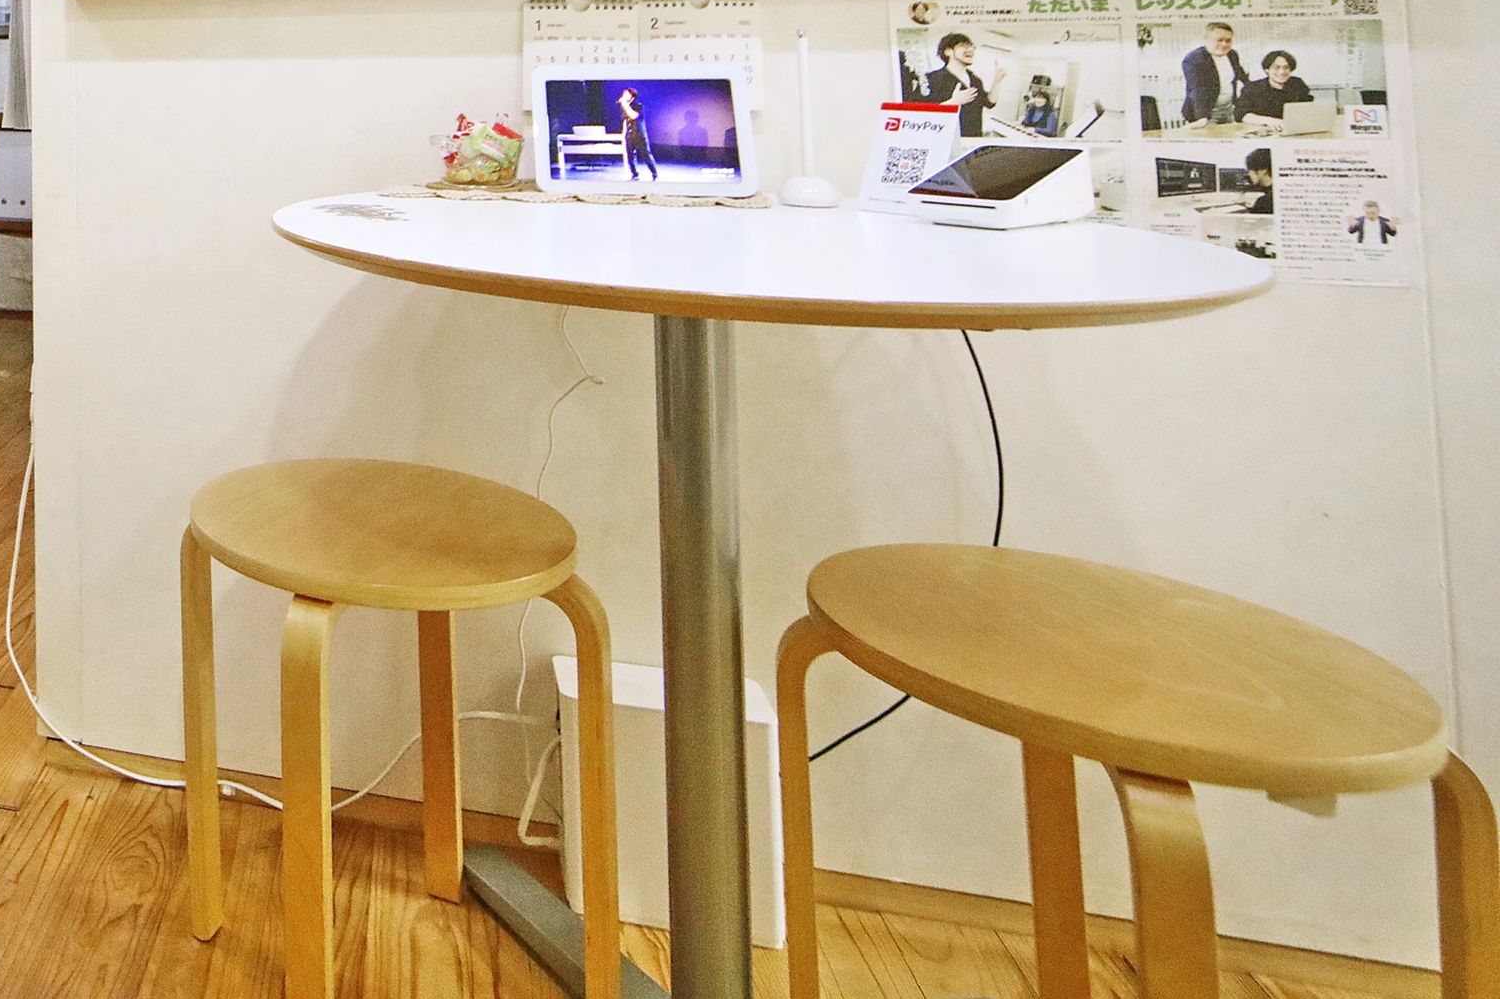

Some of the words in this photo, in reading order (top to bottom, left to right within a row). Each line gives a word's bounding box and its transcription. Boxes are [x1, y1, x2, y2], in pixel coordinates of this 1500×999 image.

[534, 19, 541, 31] 1
[650, 16, 659, 30] 2
[902, 120, 946, 132] PayPay
